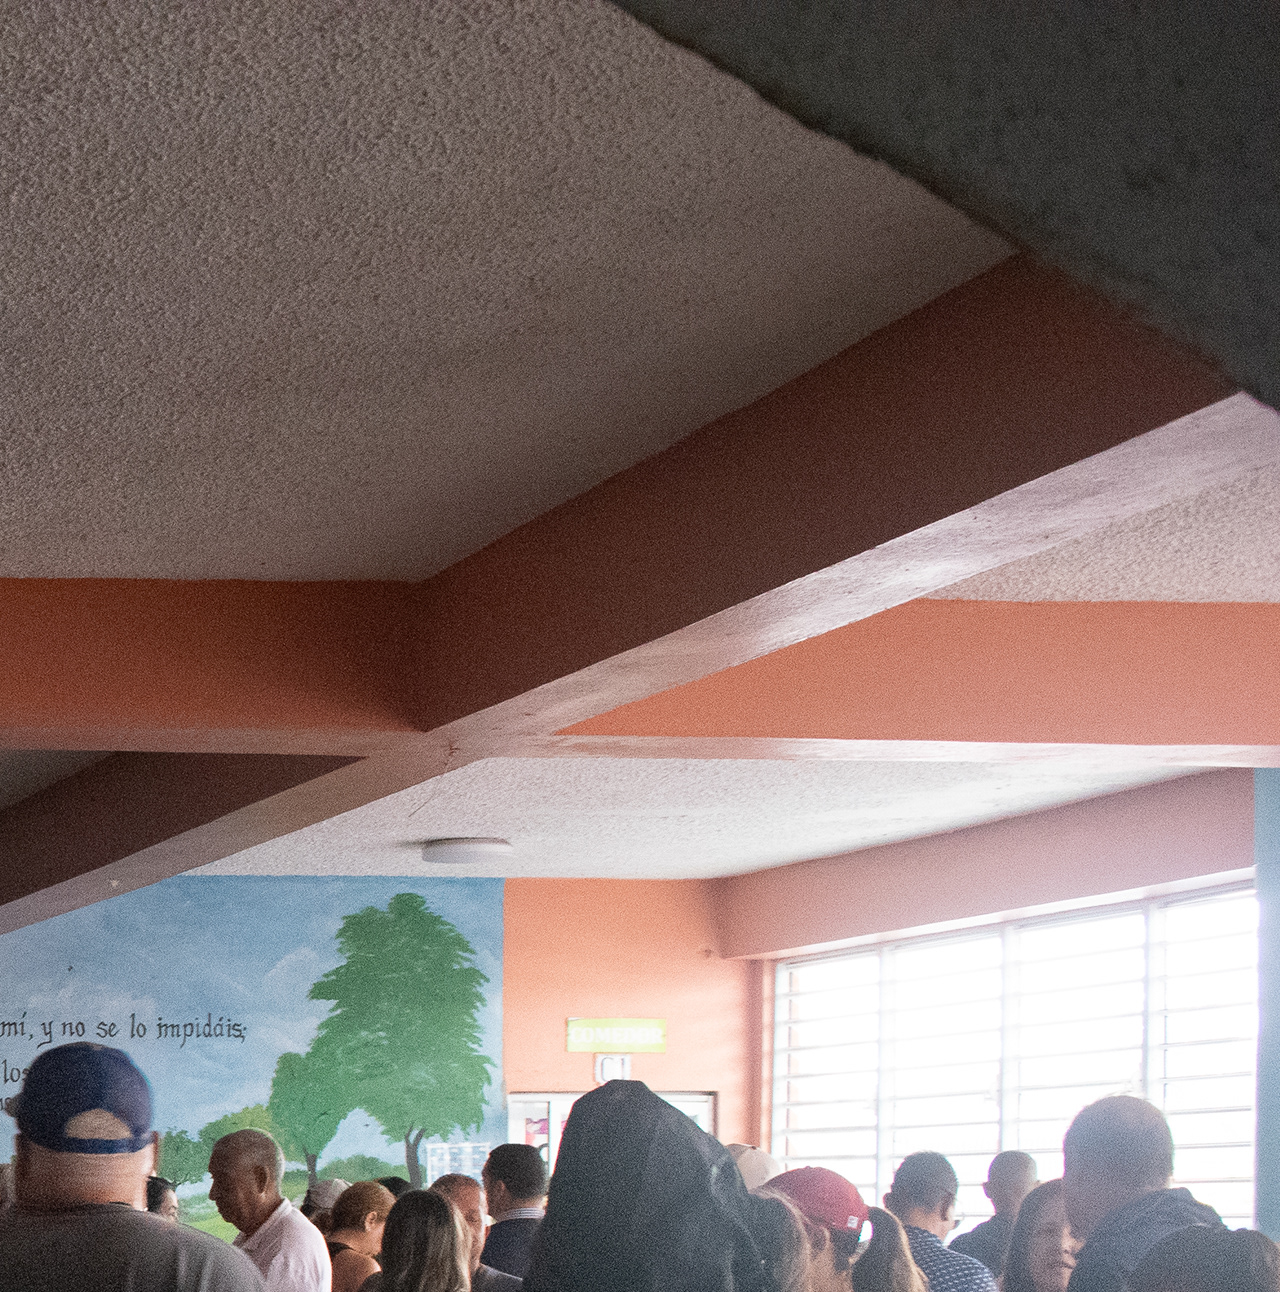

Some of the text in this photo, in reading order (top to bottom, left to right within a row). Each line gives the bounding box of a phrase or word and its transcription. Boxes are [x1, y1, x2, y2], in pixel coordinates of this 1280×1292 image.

[0, 1011, 34, 1040] mí,
[37, 1020, 53, 1049] y
[62, 1021, 86, 1038] no
[96, 1020, 121, 1038] se
[130, 1013, 147, 1038] lo
[156, 1012, 247, 1049] impidáis;
[569, 1027, 664, 1044] COMEDOR
